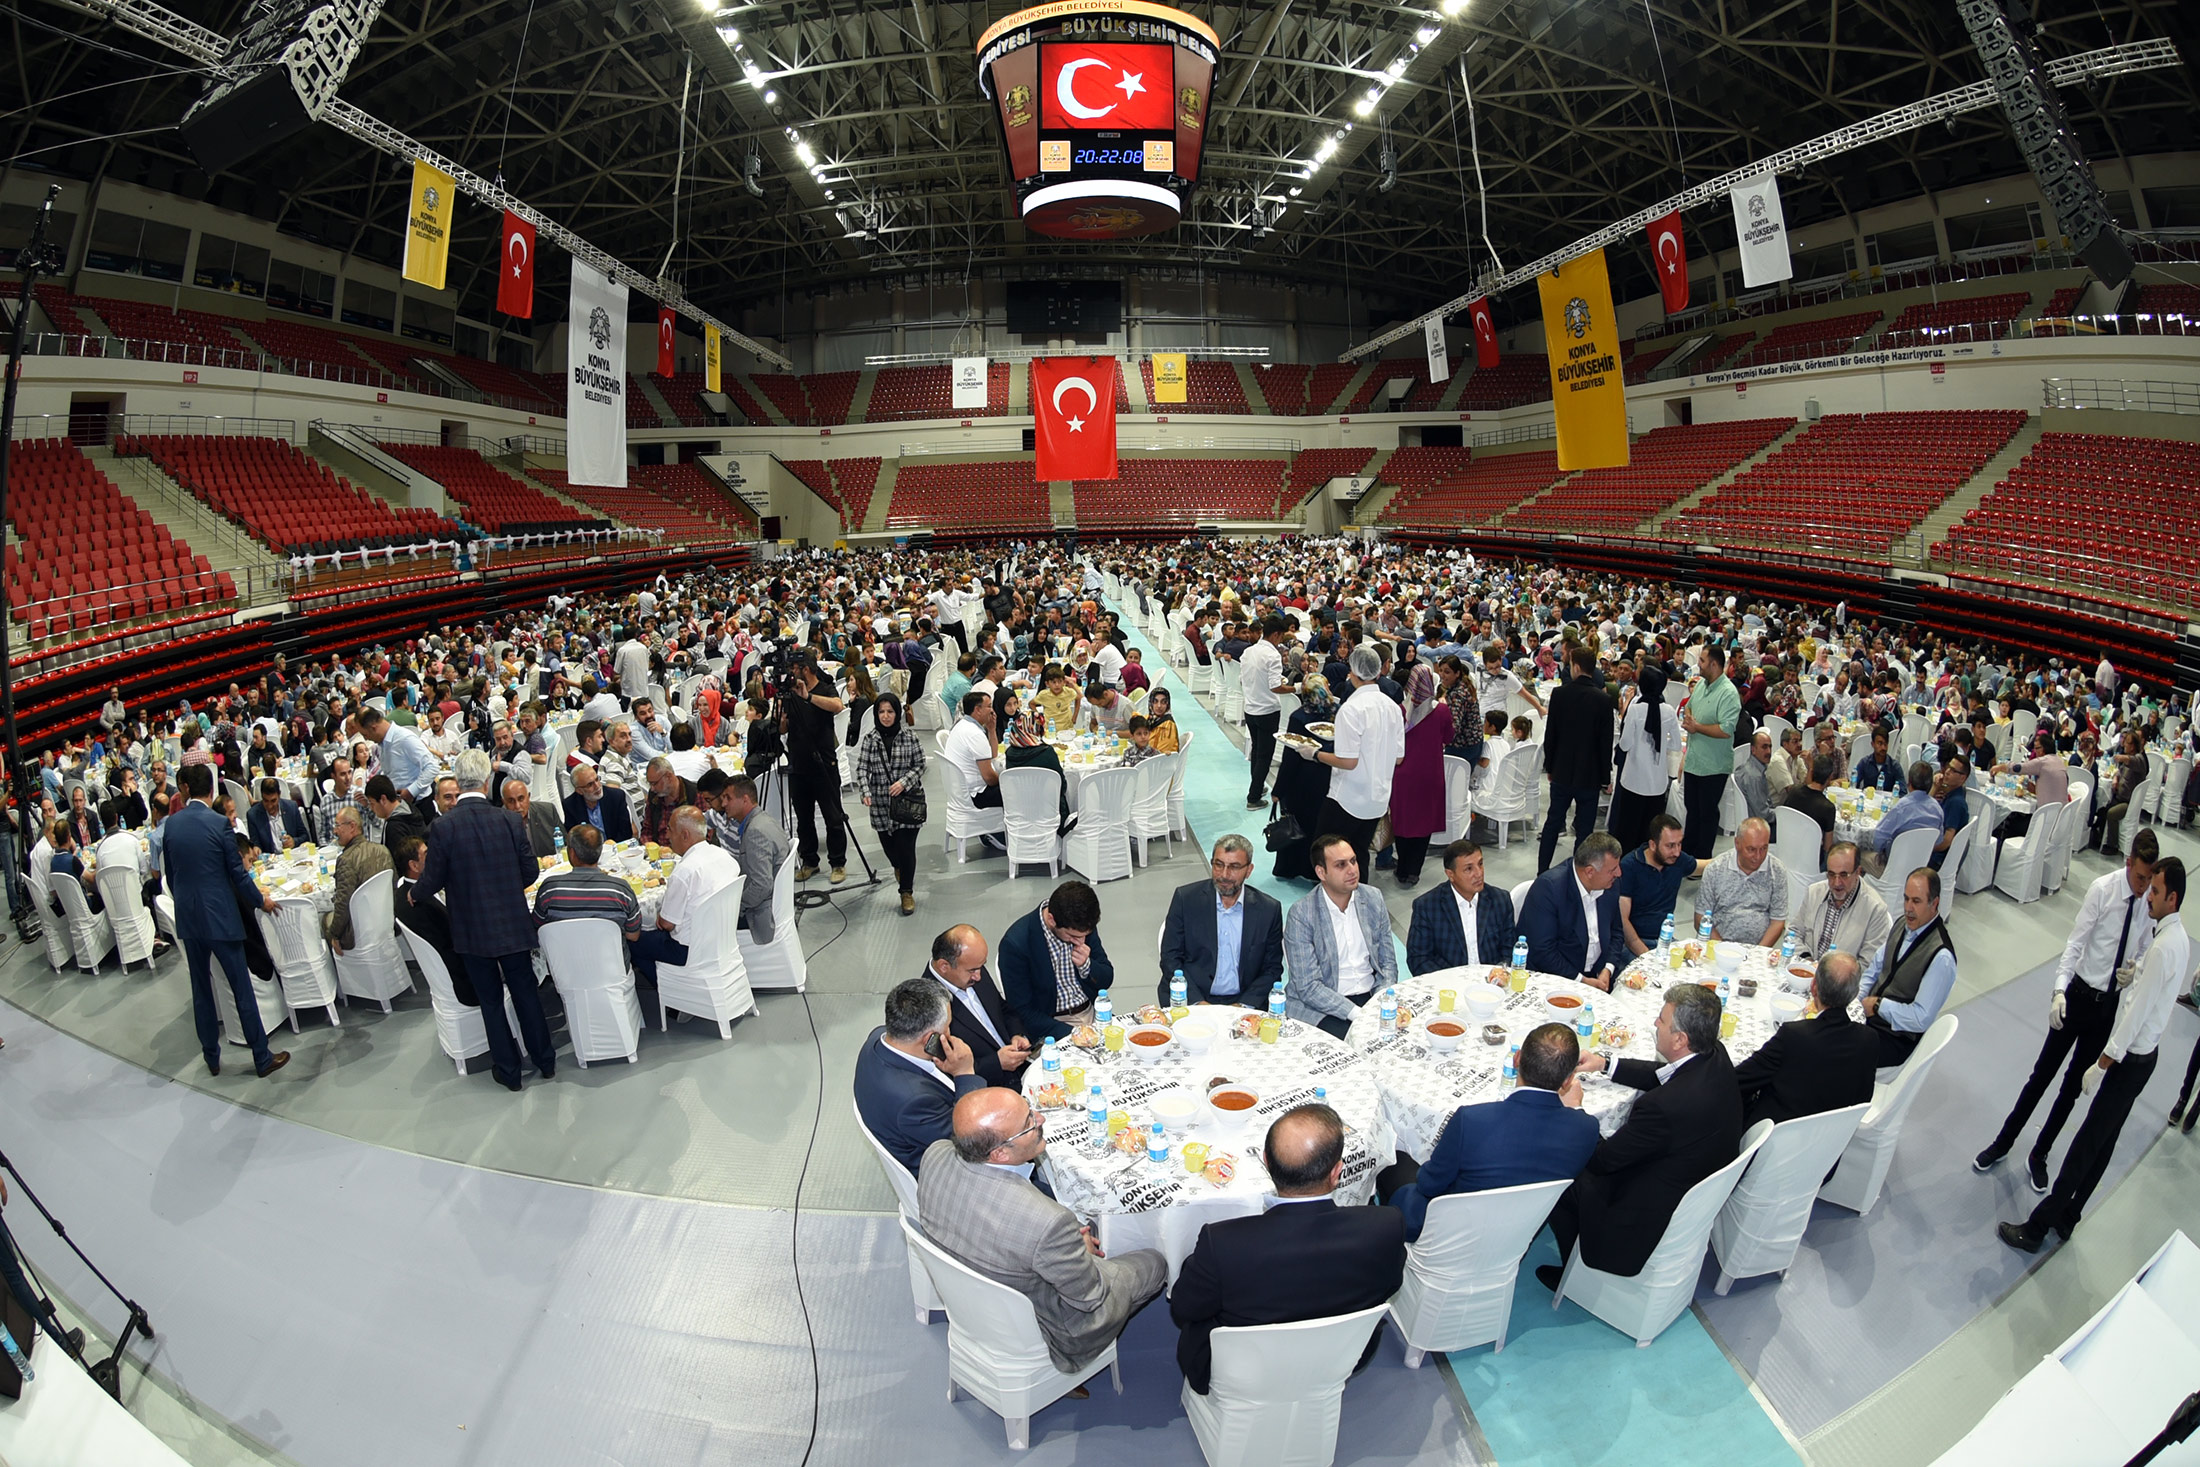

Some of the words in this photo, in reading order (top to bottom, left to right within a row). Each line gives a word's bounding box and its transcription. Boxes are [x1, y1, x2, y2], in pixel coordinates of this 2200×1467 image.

[987, 21, 1007, 38] KONYA
[1009, 5, 1064, 23] BÜYÜKŞEHİR
[1066, 1, 1123, 10] BELEDİYESİ
[1061, 17, 1178, 42] BÜYÜKŞEHİR
[1074, 149, 1144, 164] 20:22:08
[420, 211, 437, 224] KONYA
[1751, 217, 1769, 228] KONYA
[410, 217, 444, 239] BÜYÜKŞEHİR
[1744, 222, 1780, 241] BÜYÜKŞEHİR
[1568, 342, 1597, 360] KONYA
[588, 353, 610, 372] KONYA
[1557, 353, 1616, 382] BÜYÜKŞEHİR
[1706, 374, 1732, 383] Konya'yı
[1732, 369, 1757, 380] Geçmişi
[1759, 366, 1778, 376] Kadar
[1780, 362, 1803, 374] Büyük,
[1805, 358, 1839, 370] Görkemli
[1841, 357, 1851, 366] Bir
[1854, 353, 1890, 365] Geleceğe
[1892, 349, 1946, 361] Hazırlıyoruz.
[575, 365, 621, 395] BÜYÜKŞEHİR
[1570, 374, 1605, 392] BELEDİYESİ
[585, 390, 612, 405] BELEDİYESİ
[1454, 1069, 1476, 1085] KONYA
[1122, 1082, 1157, 1094] KONYA
[1119, 1183, 1156, 1207] KONYA
